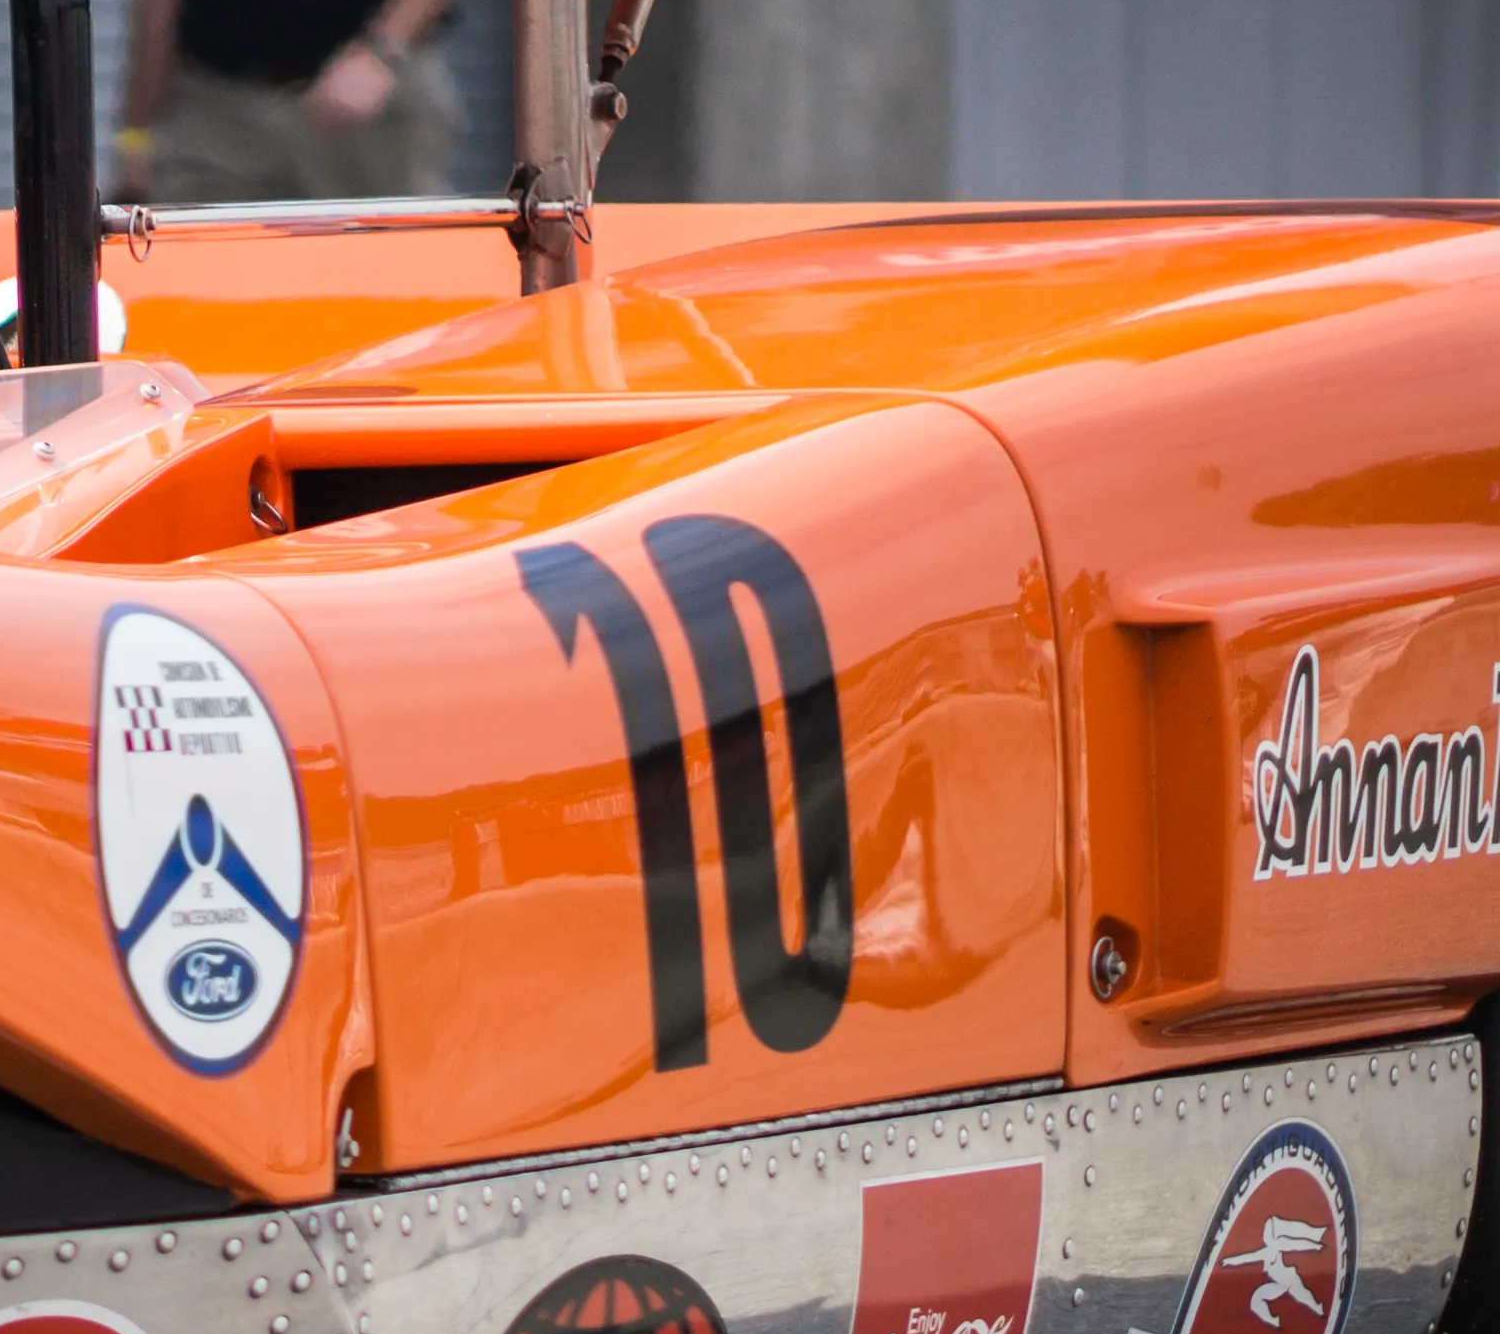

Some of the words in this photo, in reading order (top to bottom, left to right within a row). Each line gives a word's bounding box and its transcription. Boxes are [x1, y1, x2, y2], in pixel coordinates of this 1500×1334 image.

[513, 514, 856, 1073] 10
[1253, 644, 1500, 881] Annan
[181, 951, 243, 1006] Ford
